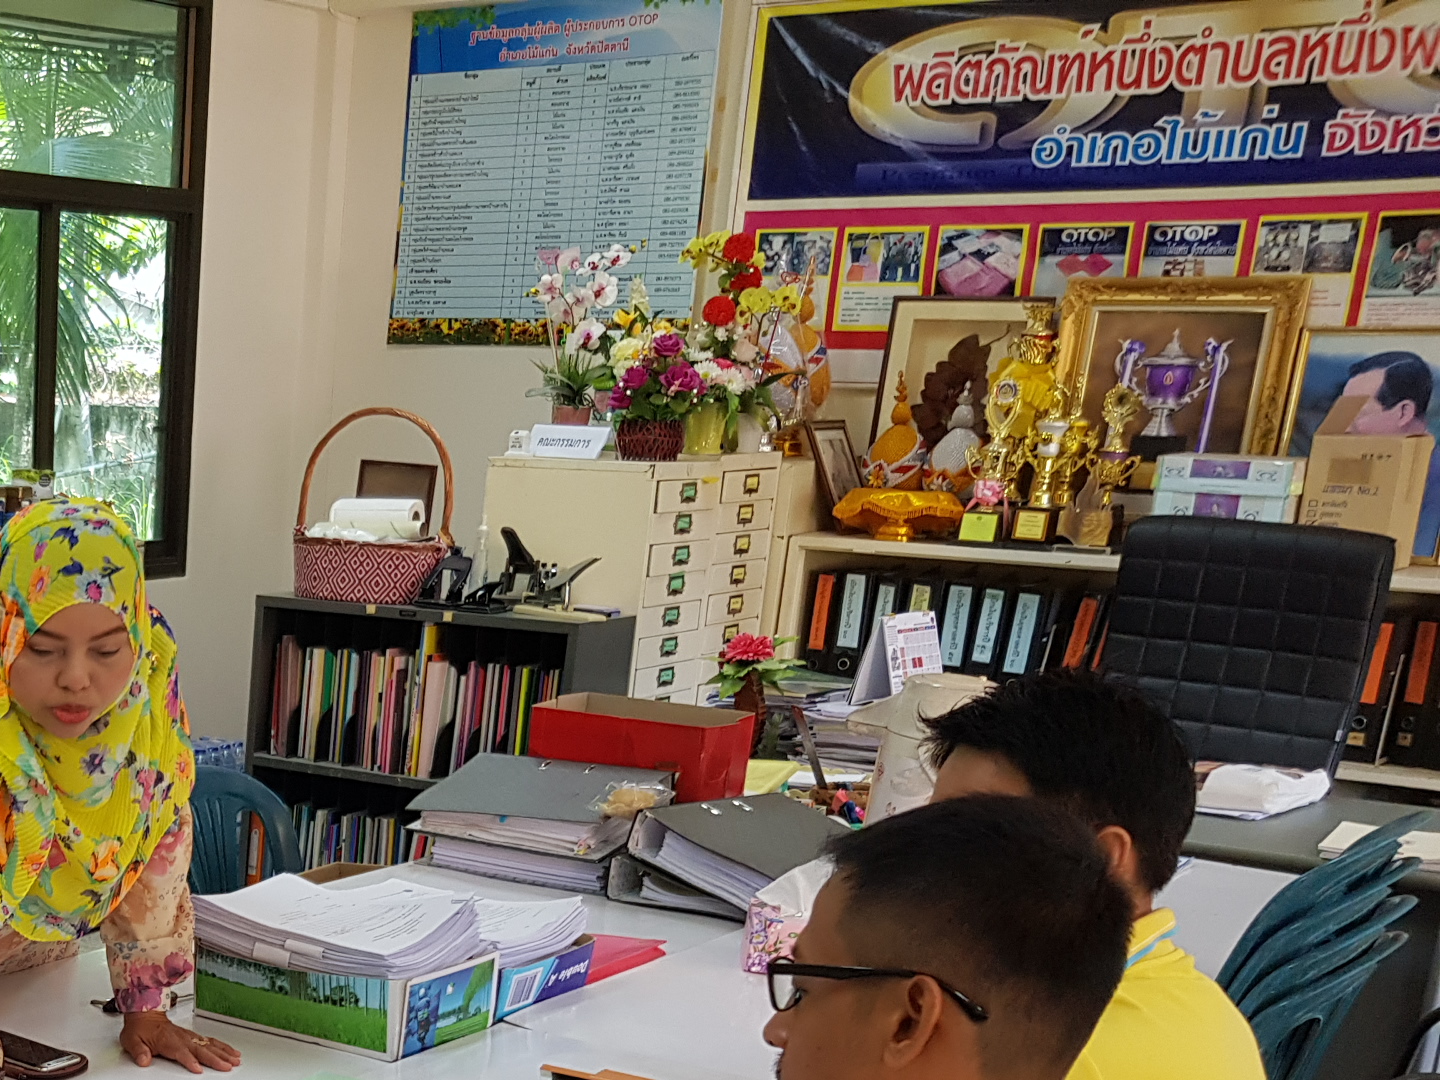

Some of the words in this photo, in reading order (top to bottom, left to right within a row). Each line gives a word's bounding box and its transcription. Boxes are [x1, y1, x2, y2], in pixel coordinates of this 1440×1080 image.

[469, 21, 561, 46] ฐานข้อมูลกลุ่มผู้ผลิต
[563, 17, 625, 37] ผู้ประกอบการ
[629, 13, 659, 27] OTOP
[499, 45, 559, 62] อำเภอไม้แก่น
[565, 37, 630, 56] จังหวัดปัตตานี
[1032, 107, 1309, 169] อำเภอไม้แก่น
[1061, 227, 1116, 244] OTOP
[1153, 225, 1219, 242] OTOP
[537, 437, 592, 449] คณะกรรมการ
[547, 973, 558, 987] A
[558, 959, 590, 982] Double
